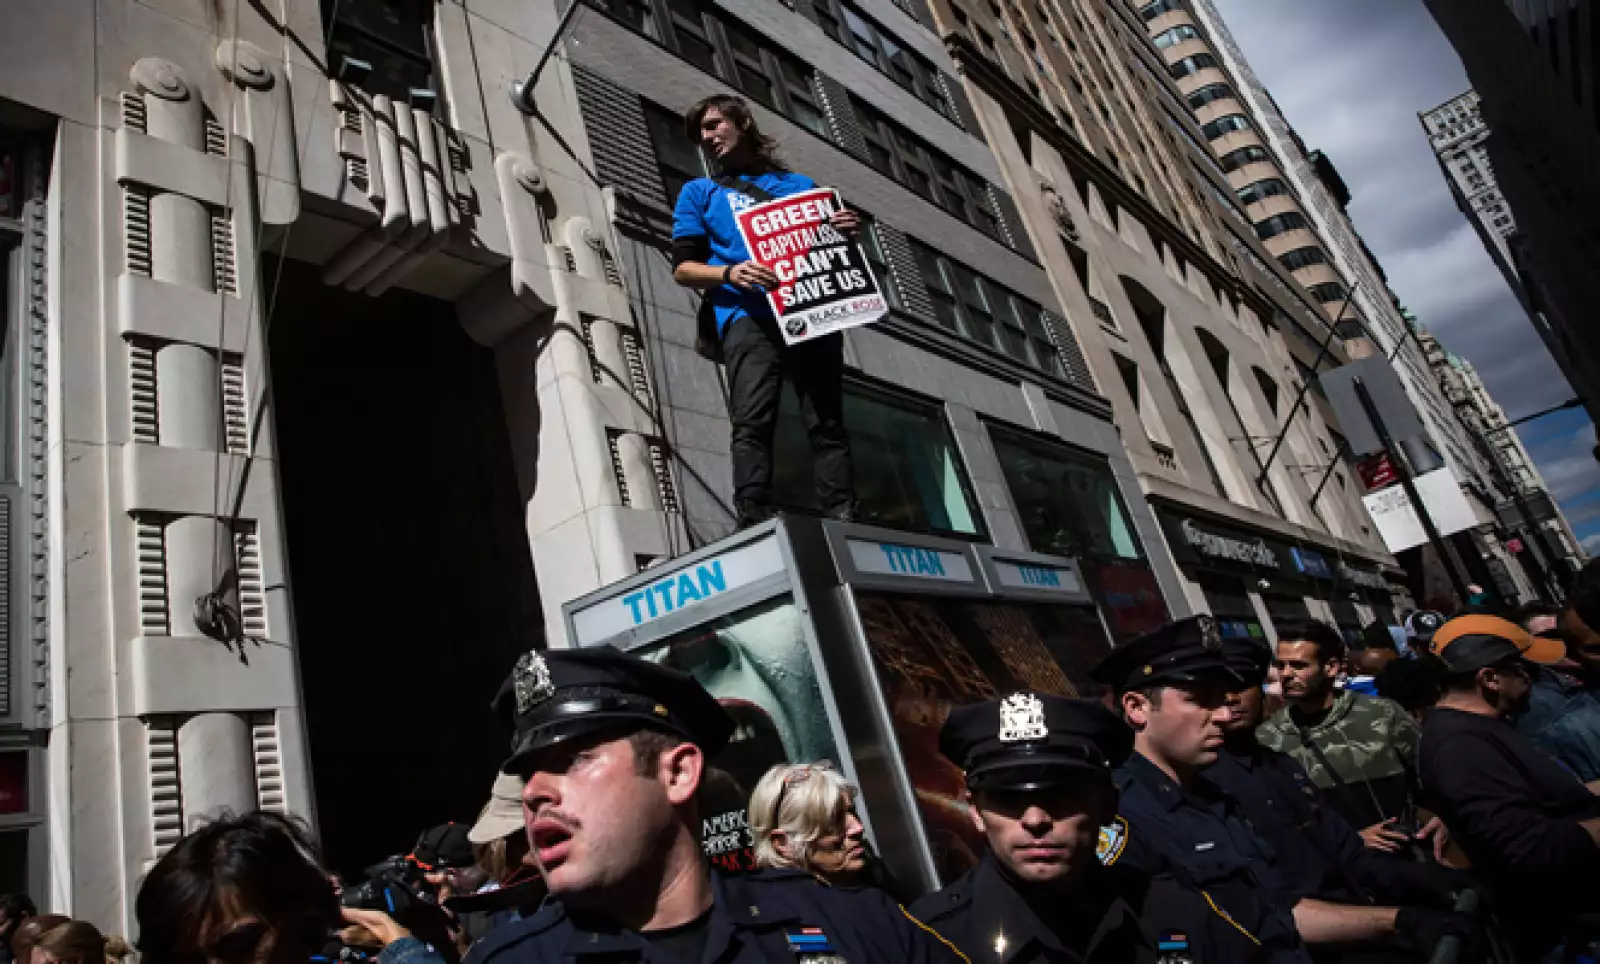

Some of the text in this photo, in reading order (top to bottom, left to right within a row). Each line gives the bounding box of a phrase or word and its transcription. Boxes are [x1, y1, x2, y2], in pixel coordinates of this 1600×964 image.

[751, 198, 835, 236] GREEN
[775, 246, 851, 282] CAN'T
[779, 269, 867, 306] SAVE US
[807, 305, 848, 324] BLACK
[879, 543, 946, 577] TITAN
[1017, 565, 1061, 587] TITAN
[622, 558, 726, 625] TITAN
[703, 810, 750, 836] AMERIC
